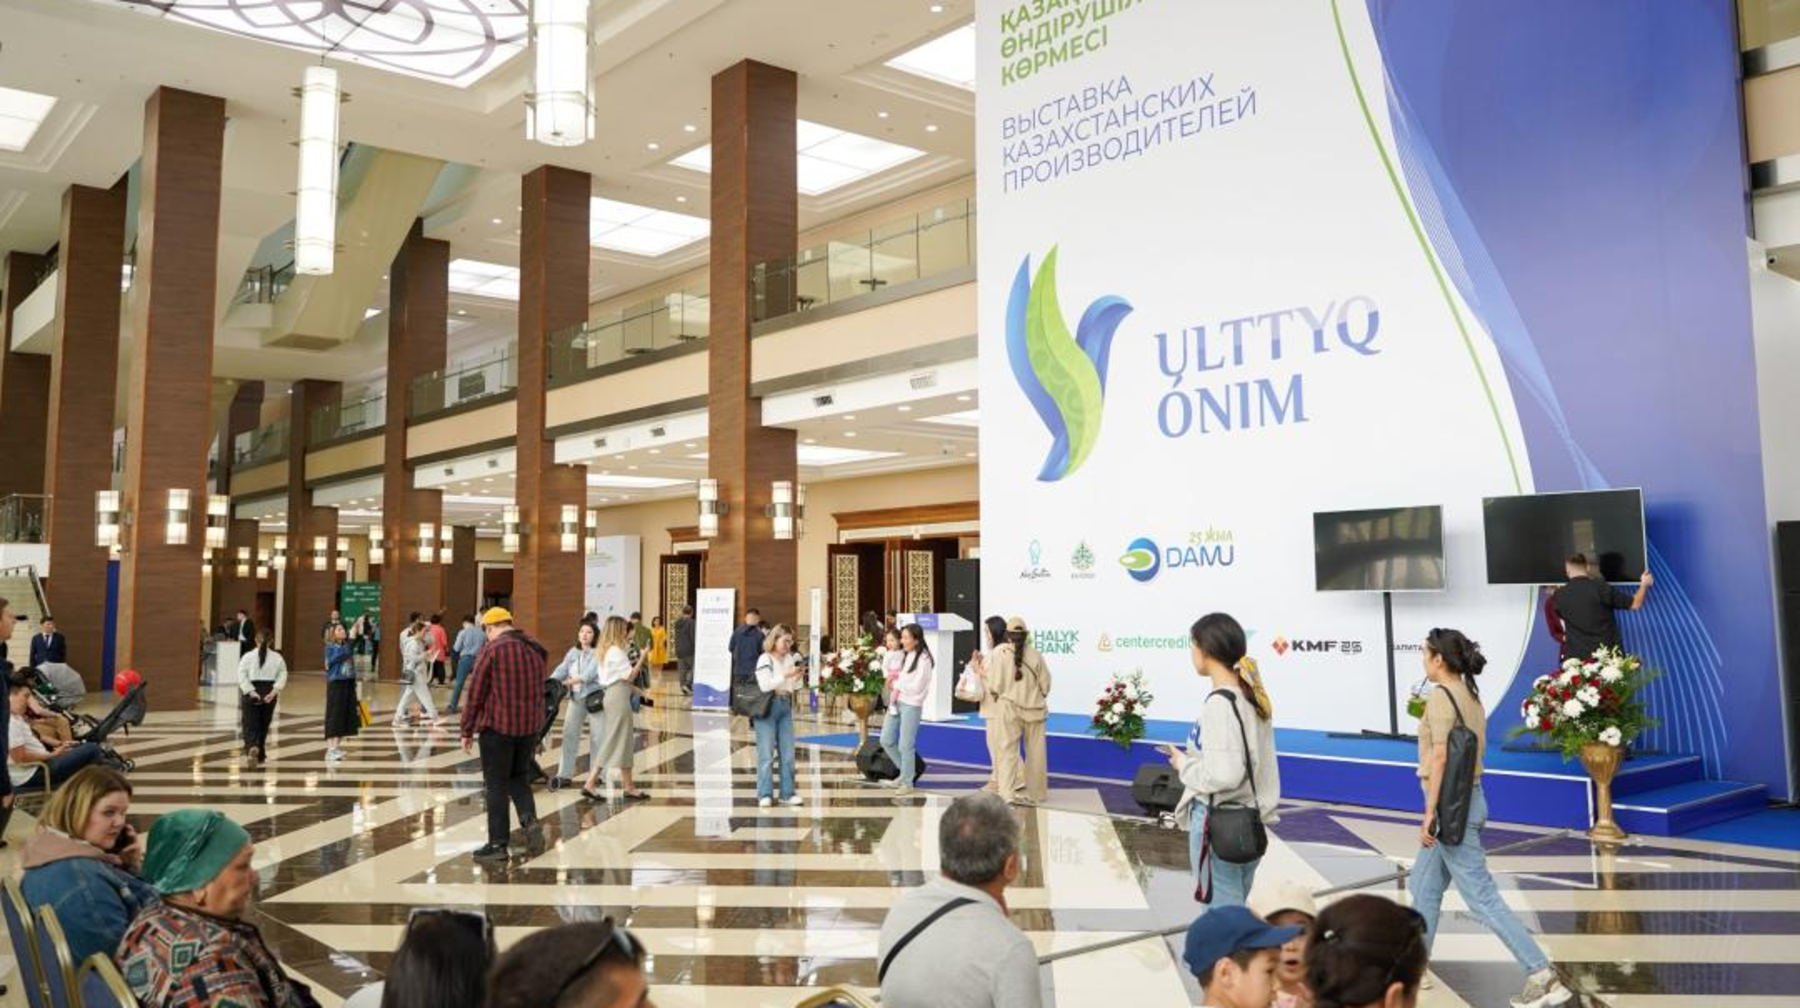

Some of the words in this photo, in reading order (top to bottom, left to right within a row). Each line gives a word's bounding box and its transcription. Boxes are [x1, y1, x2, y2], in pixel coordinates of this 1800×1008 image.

[1000, 0, 1081, 33] ҚАЗА
[1001, 24, 1108, 86] КӨРМЕСІ
[1002, 75, 1133, 140] ВЫСТАВКА
[1003, 72, 1216, 167] КАЗАХСТАНСКИХ
[1003, 86, 1257, 193] ПРОИЗВОДИТЕЛЕЙ
[1153, 295, 1382, 378] ULTTYQ
[1166, 545, 1234, 568] DAMU
[1034, 629, 1079, 642] HALYK
[1034, 641, 1075, 655] BANK
[1291, 640, 1337, 652] KMF
